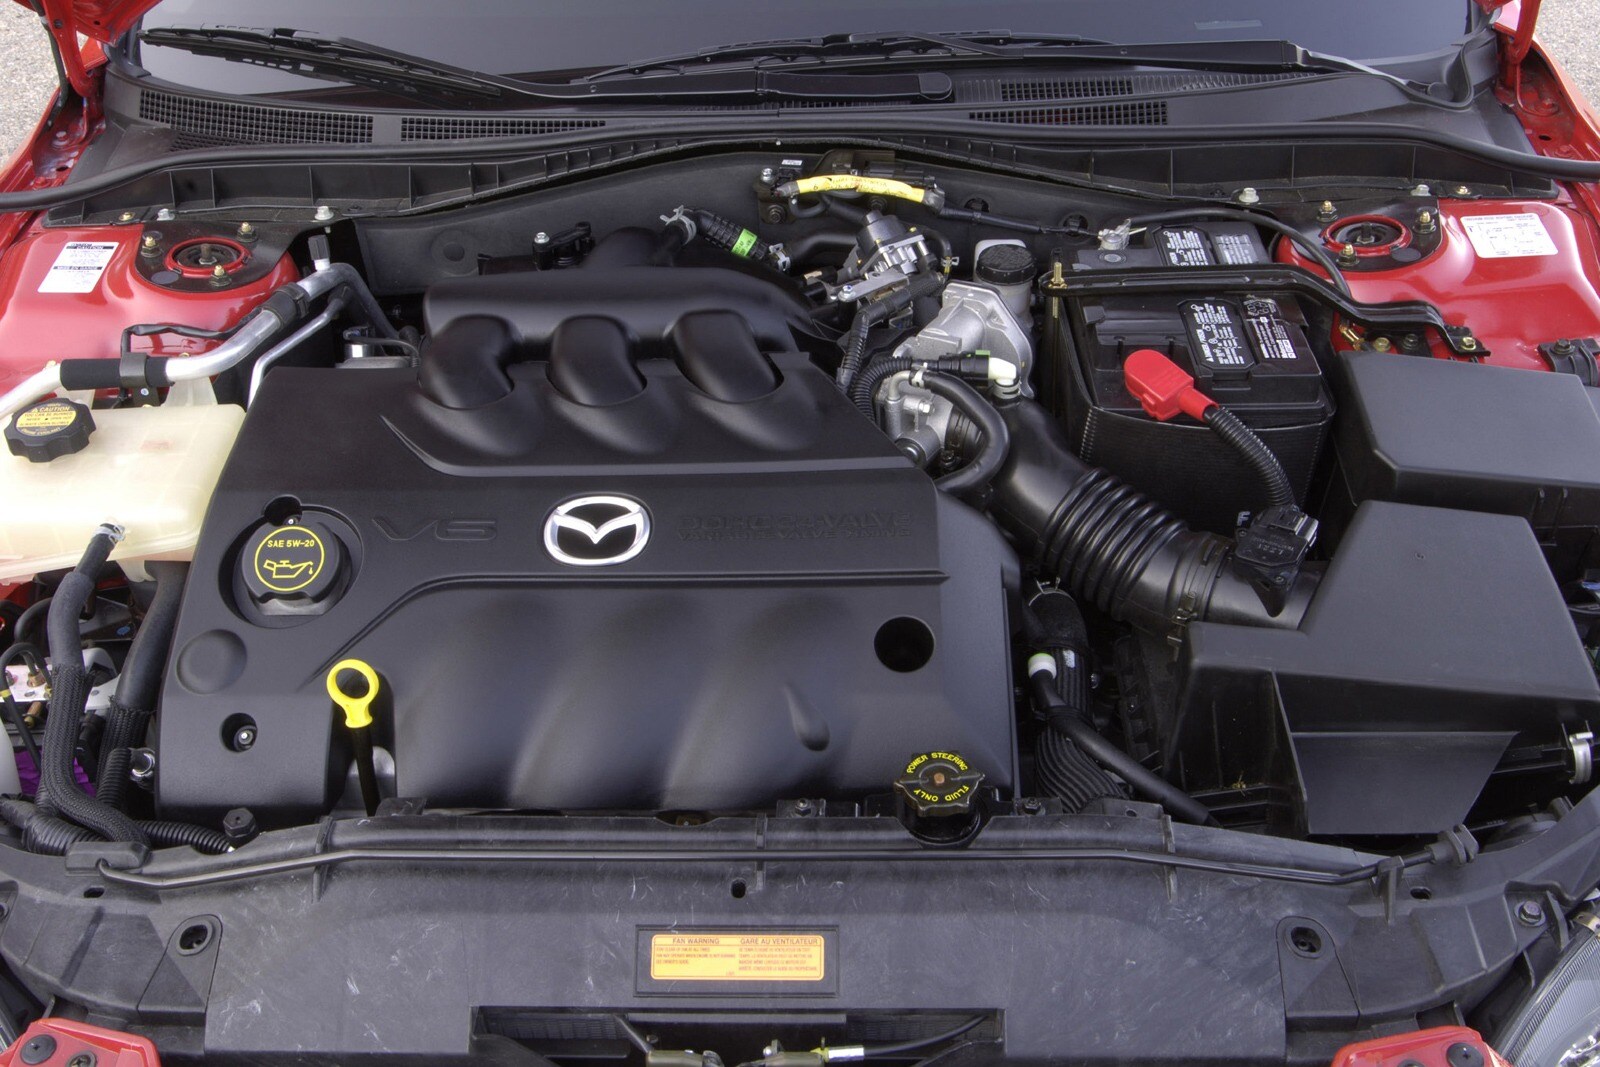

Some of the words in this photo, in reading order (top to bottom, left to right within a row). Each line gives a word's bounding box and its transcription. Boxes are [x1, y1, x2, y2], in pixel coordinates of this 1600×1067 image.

[371, 518, 498, 541] V6
[267, 540, 284, 548] SAE
[286, 540, 315, 548] 5W-20
[906, 754, 929, 774] POWER
[931, 752, 968, 771] STEERING
[913, 788, 939, 802] ONLY
[944, 785, 970, 802] FLUID
